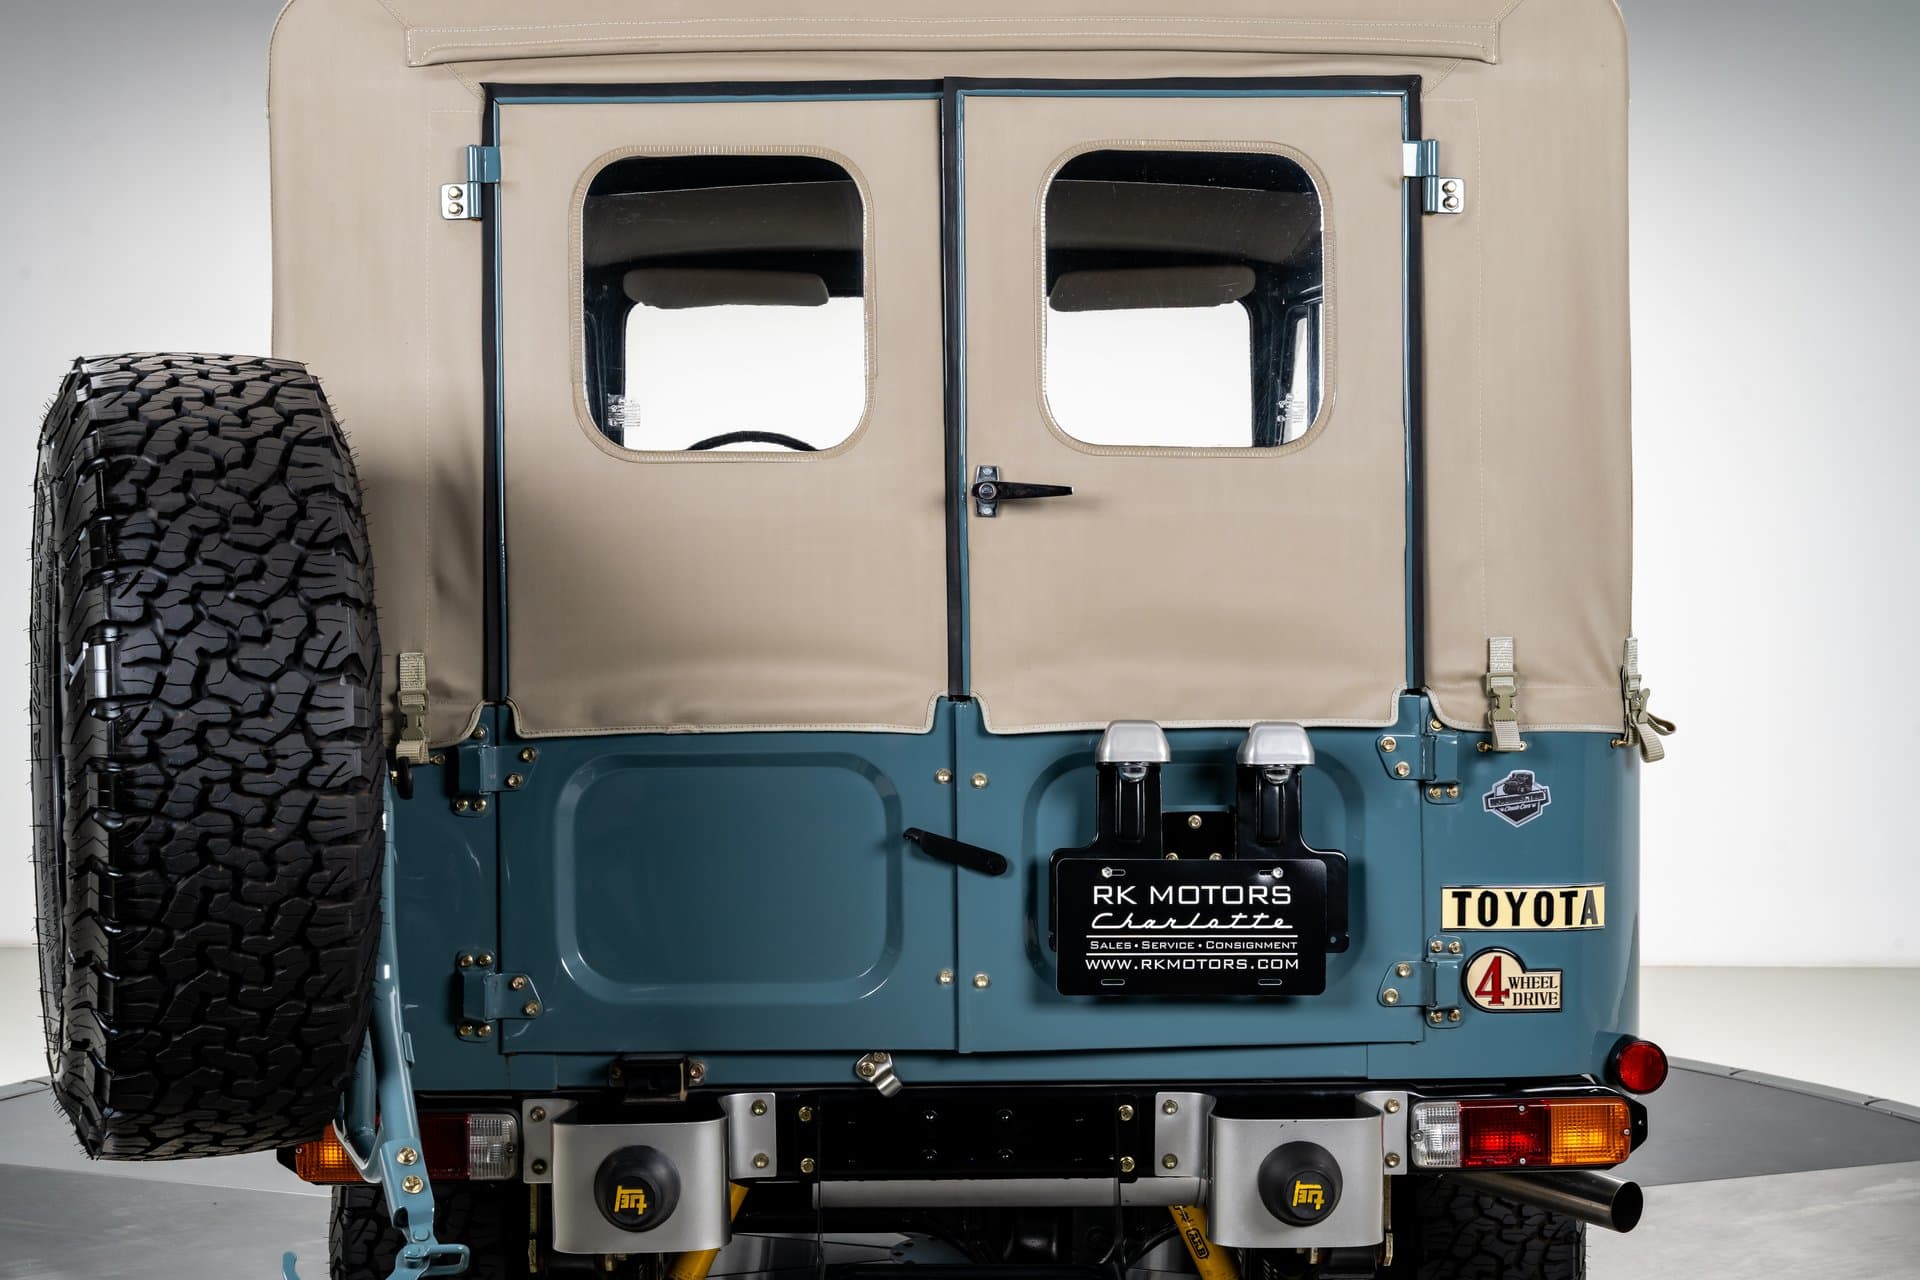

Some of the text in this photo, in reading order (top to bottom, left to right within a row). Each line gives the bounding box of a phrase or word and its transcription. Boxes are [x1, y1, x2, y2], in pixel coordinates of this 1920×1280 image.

[1093, 885, 1292, 905] RK MOTORS
[1452, 889, 1599, 927] TOYOTA
[1091, 912, 1294, 930] Charlotte
[1085, 958, 1299, 970] WWW.RKMOTORS.COM
[1475, 956, 1558, 1006] 4 WHEEL
[1513, 991, 1559, 1006] DRIVE
